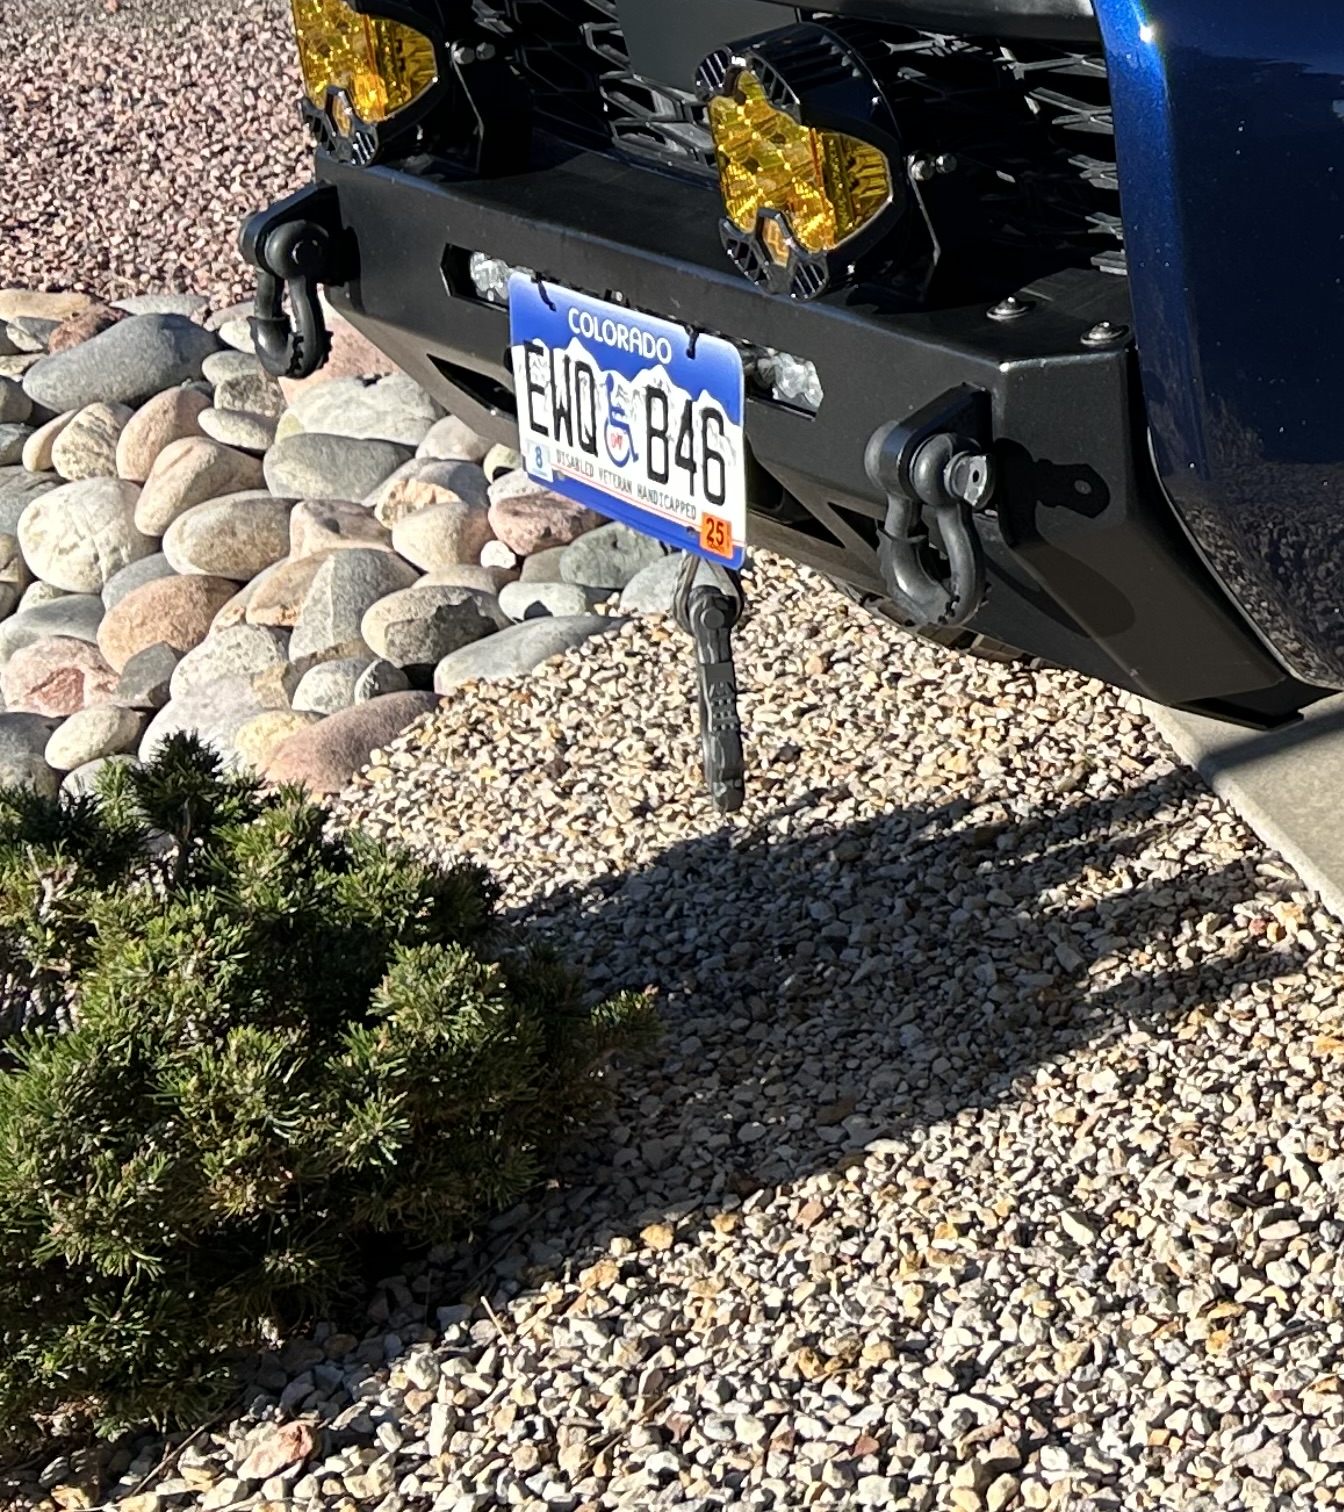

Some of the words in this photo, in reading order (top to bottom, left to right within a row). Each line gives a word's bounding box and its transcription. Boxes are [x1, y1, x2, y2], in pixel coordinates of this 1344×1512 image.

[567, 307, 673, 365] COLORADO
[523, 340, 599, 458] EWQ
[646, 384, 727, 507] B46
[534, 445, 543, 469] 8
[555, 448, 595, 478] DISABLED
[598, 464, 634, 494] VETERAN
[636, 481, 698, 521] HANDICAPPED
[705, 516, 724, 546] 25
